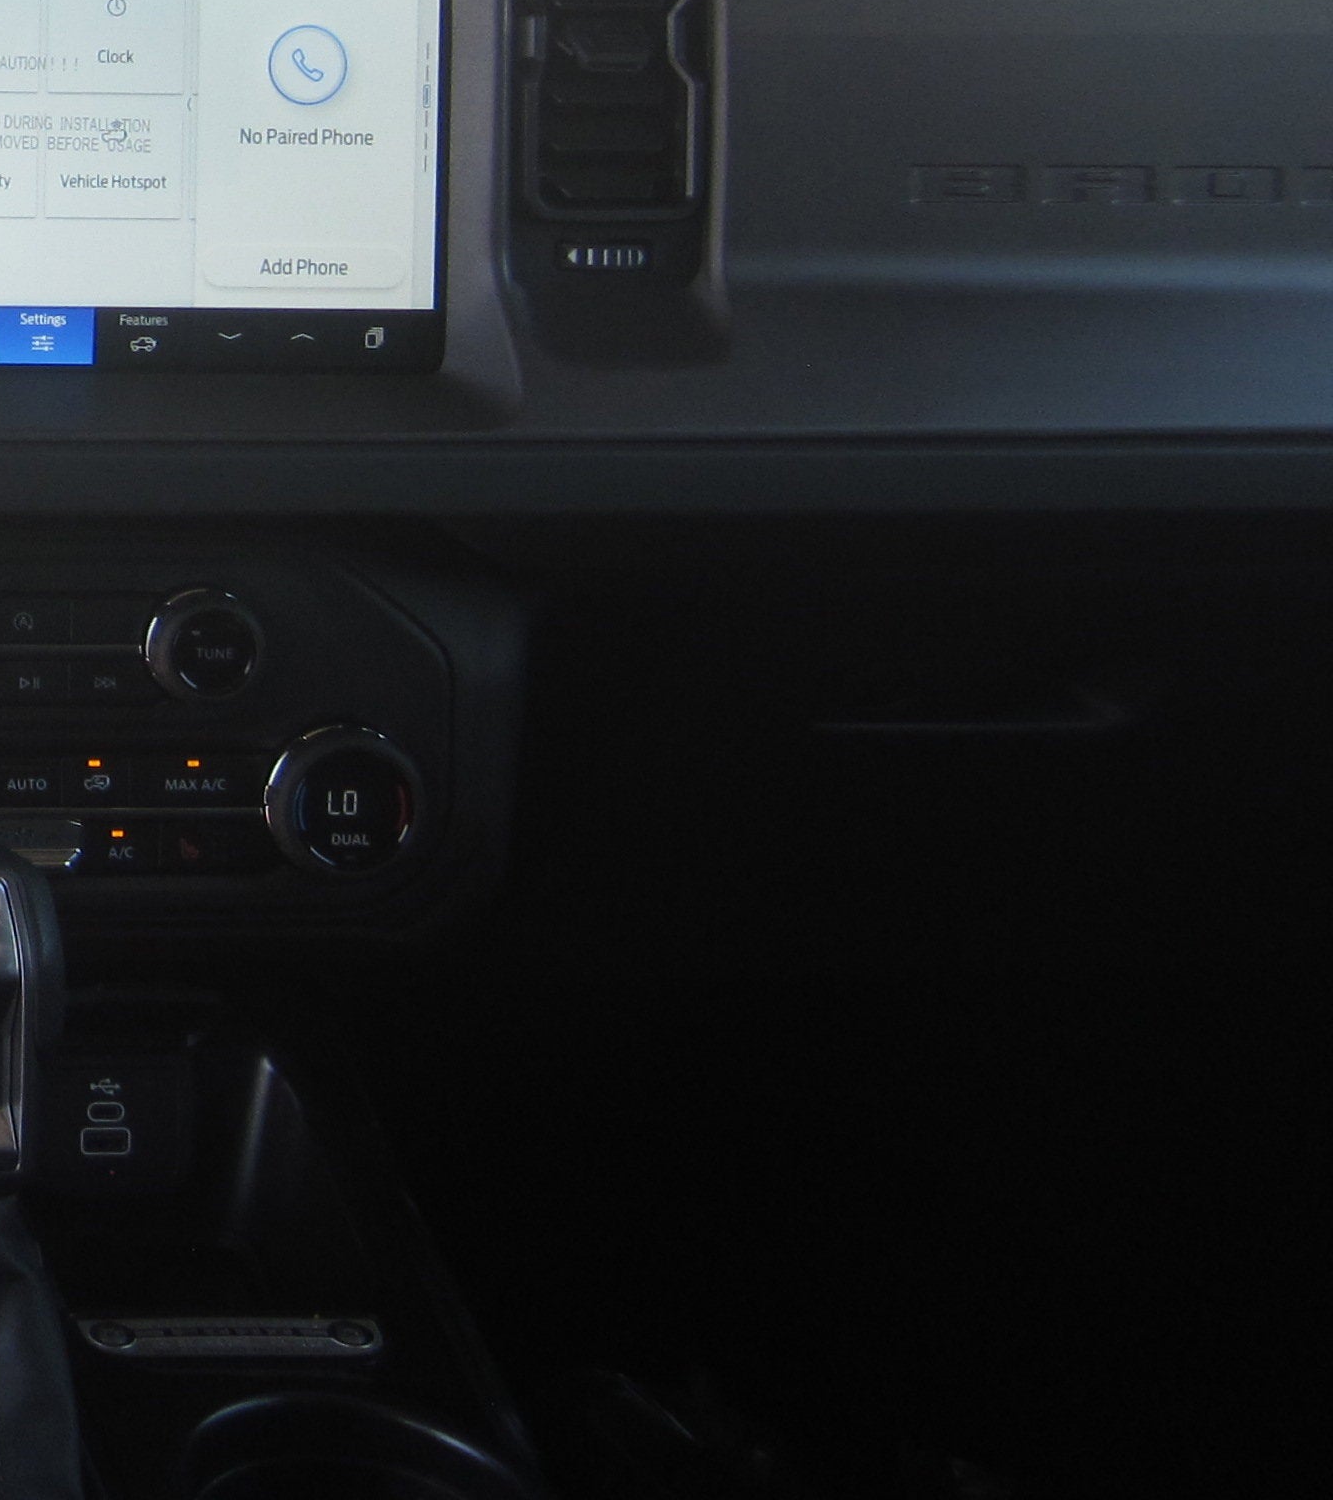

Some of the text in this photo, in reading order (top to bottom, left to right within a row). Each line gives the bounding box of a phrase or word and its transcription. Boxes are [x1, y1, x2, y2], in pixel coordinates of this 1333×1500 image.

[96, 49, 135, 64] Clock
[3, 115, 54, 131] DURING
[239, 127, 375, 147] No Paired Phone
[46, 136, 100, 152] BEFORE
[107, 138, 152, 154] USAGE
[59, 173, 168, 192] Vehicle Hotspot
[259, 257, 349, 276] Add Phone
[19, 311, 68, 328] Settings
[118, 312, 169, 327] Features
[195, 646, 236, 660] TUNE
[6, 778, 47, 791] AUTO
[164, 778, 228, 792] MAX A/C
[331, 832, 370, 846] DUAL
[107, 846, 134, 860] A/C
